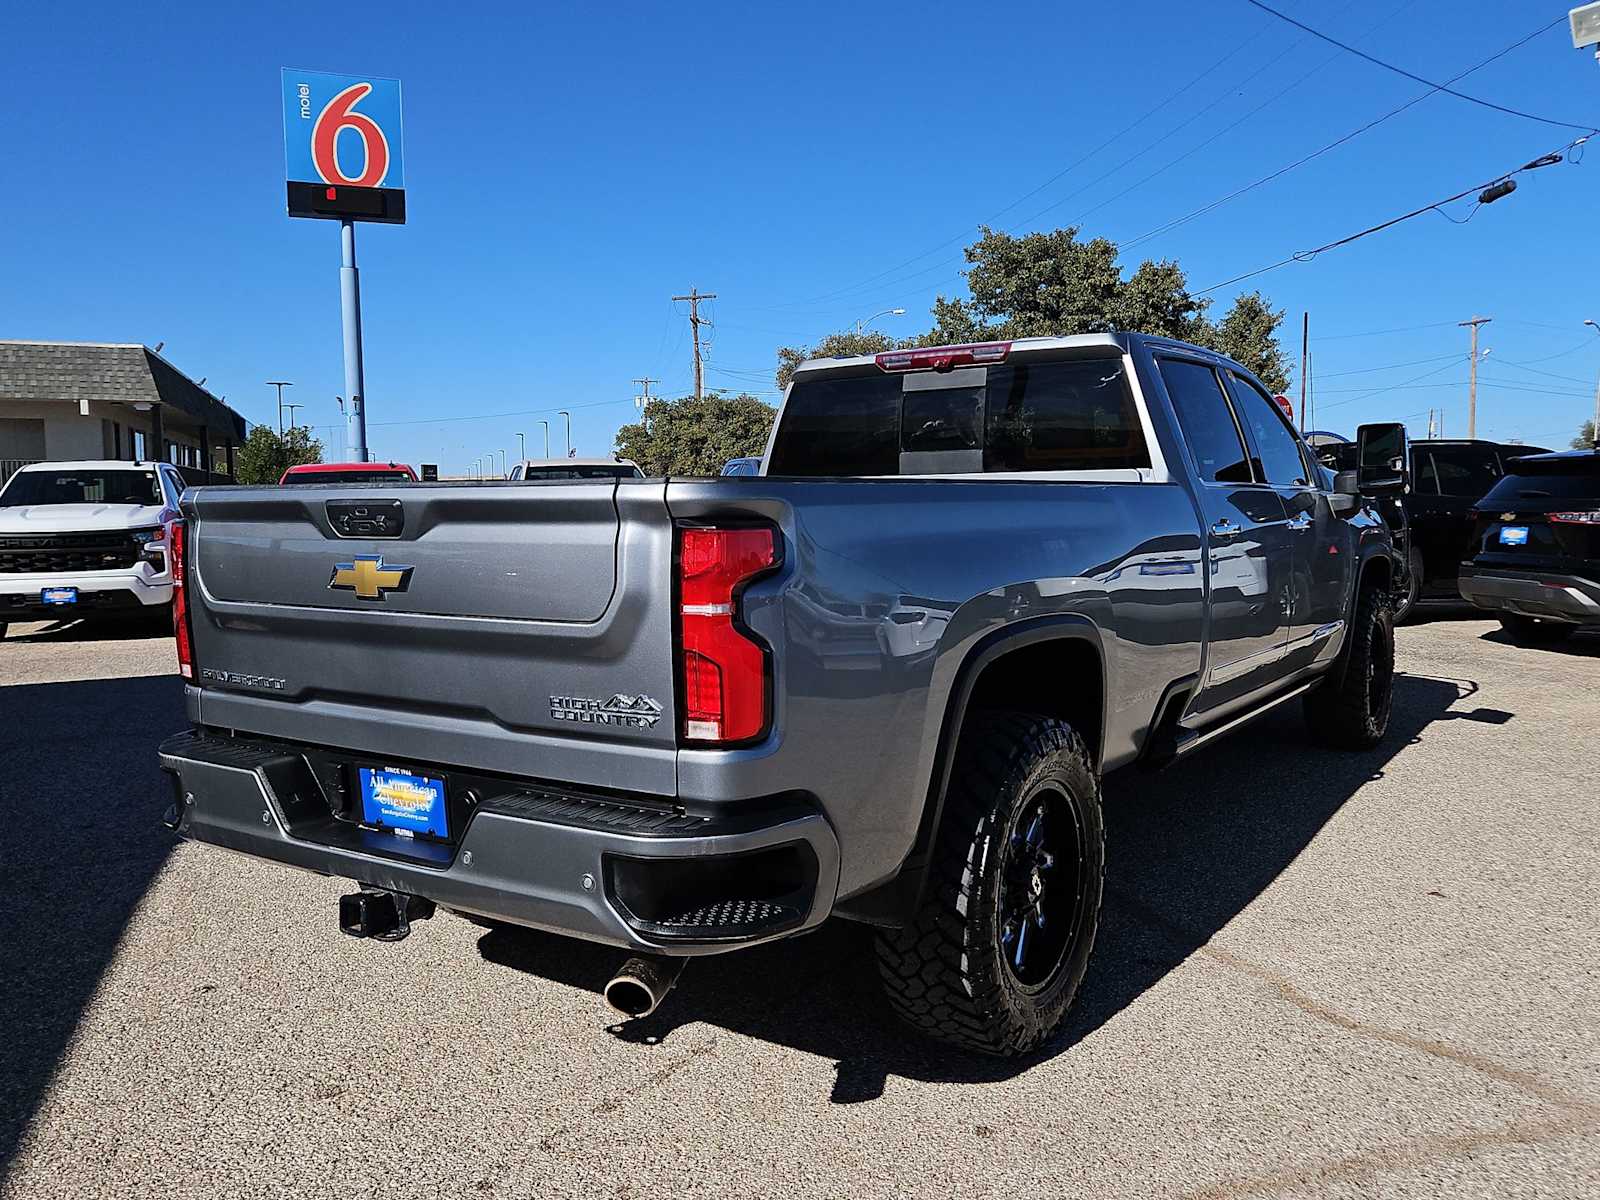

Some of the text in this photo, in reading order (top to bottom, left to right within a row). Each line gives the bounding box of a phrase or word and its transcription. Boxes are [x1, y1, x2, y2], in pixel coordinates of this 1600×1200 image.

[296, 83, 311, 120] motel
[311, 81, 390, 188] 6
[201, 668, 286, 689] SILVERADO
[549, 695, 602, 711] HIGH
[550, 708, 661, 729] COUNTRY
[384, 766, 401, 775] SINCE
[369, 775, 438, 798] All American
[376, 791, 433, 813] Chevrolet
